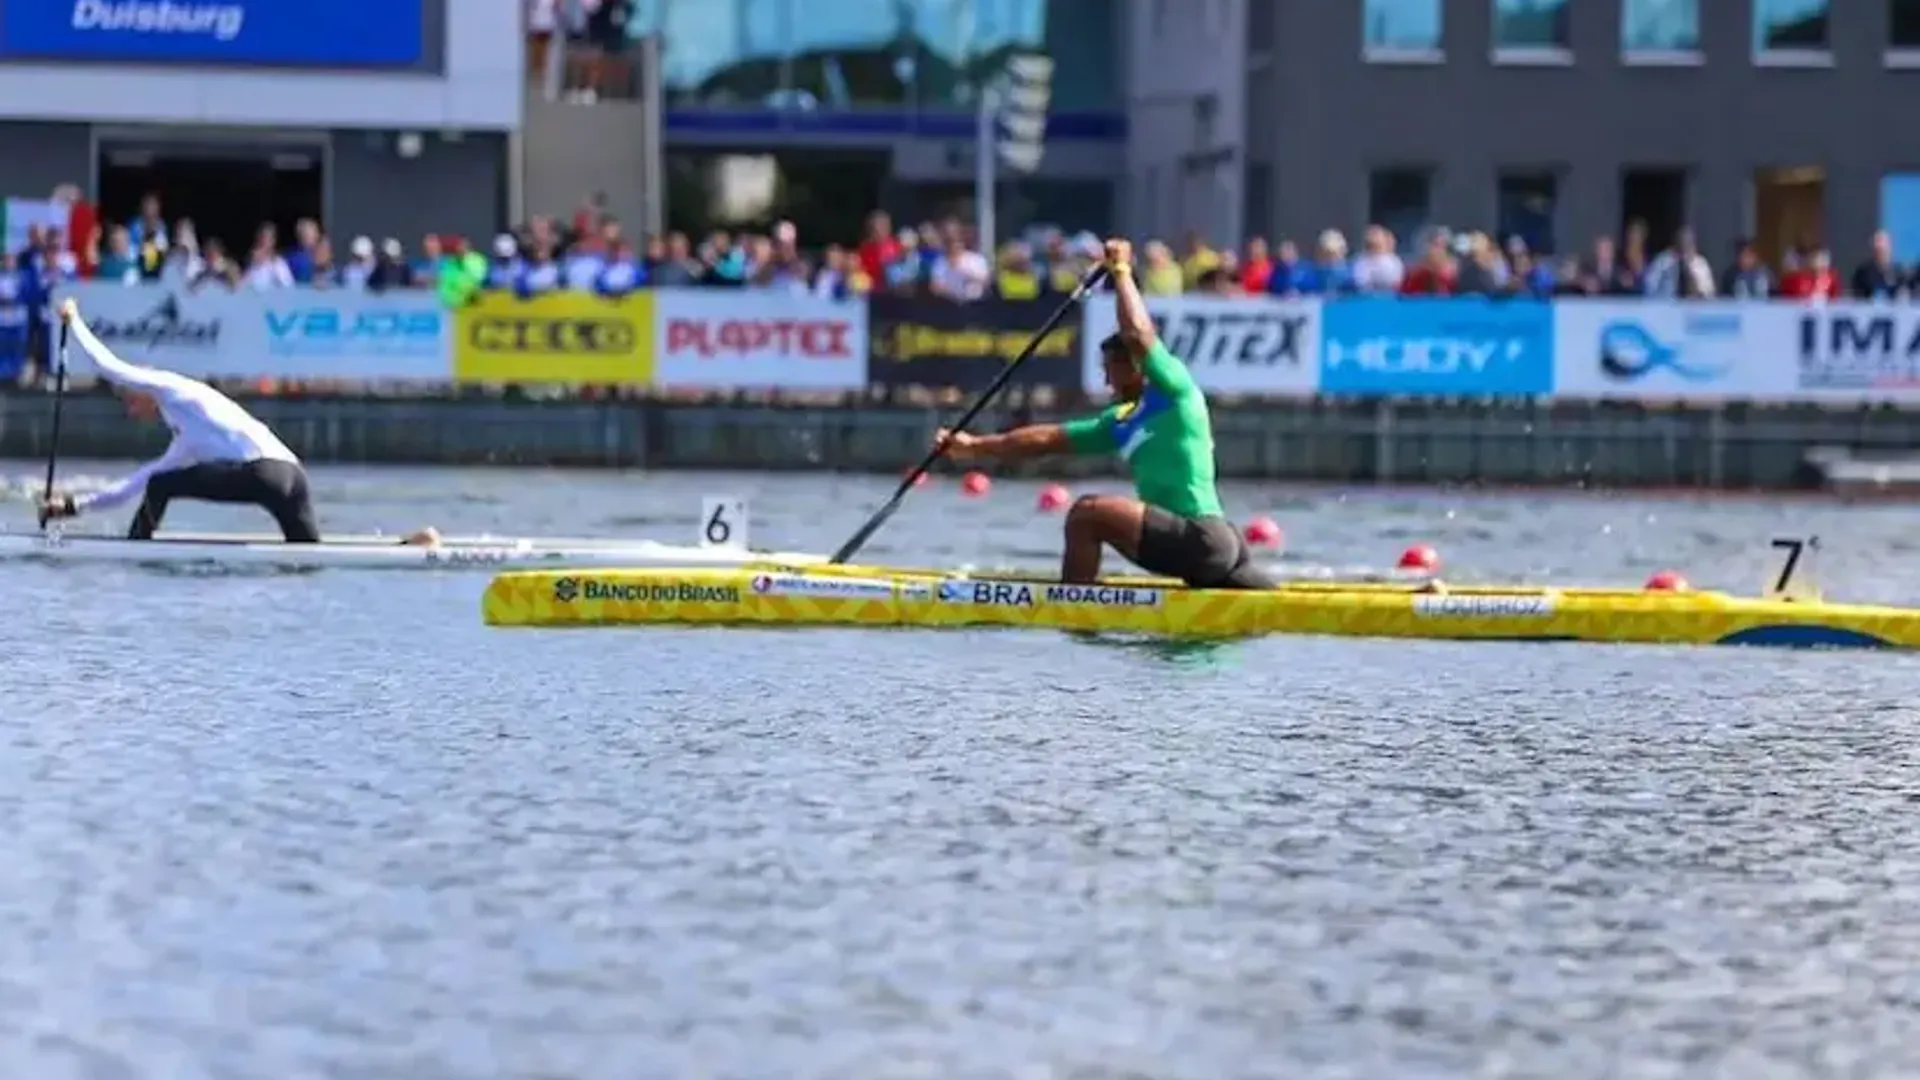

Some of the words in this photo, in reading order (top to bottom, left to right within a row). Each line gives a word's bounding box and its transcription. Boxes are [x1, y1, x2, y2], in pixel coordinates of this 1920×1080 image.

[73, 0, 243, 41] Duisburg
[706, 503, 730, 544] 6
[1771, 539, 1804, 592] 7
[583, 580, 649, 601] BANCO
[651, 584, 677, 601] DO
[678, 582, 740, 603] BRASIL
[973, 582, 1034, 608] BRA
